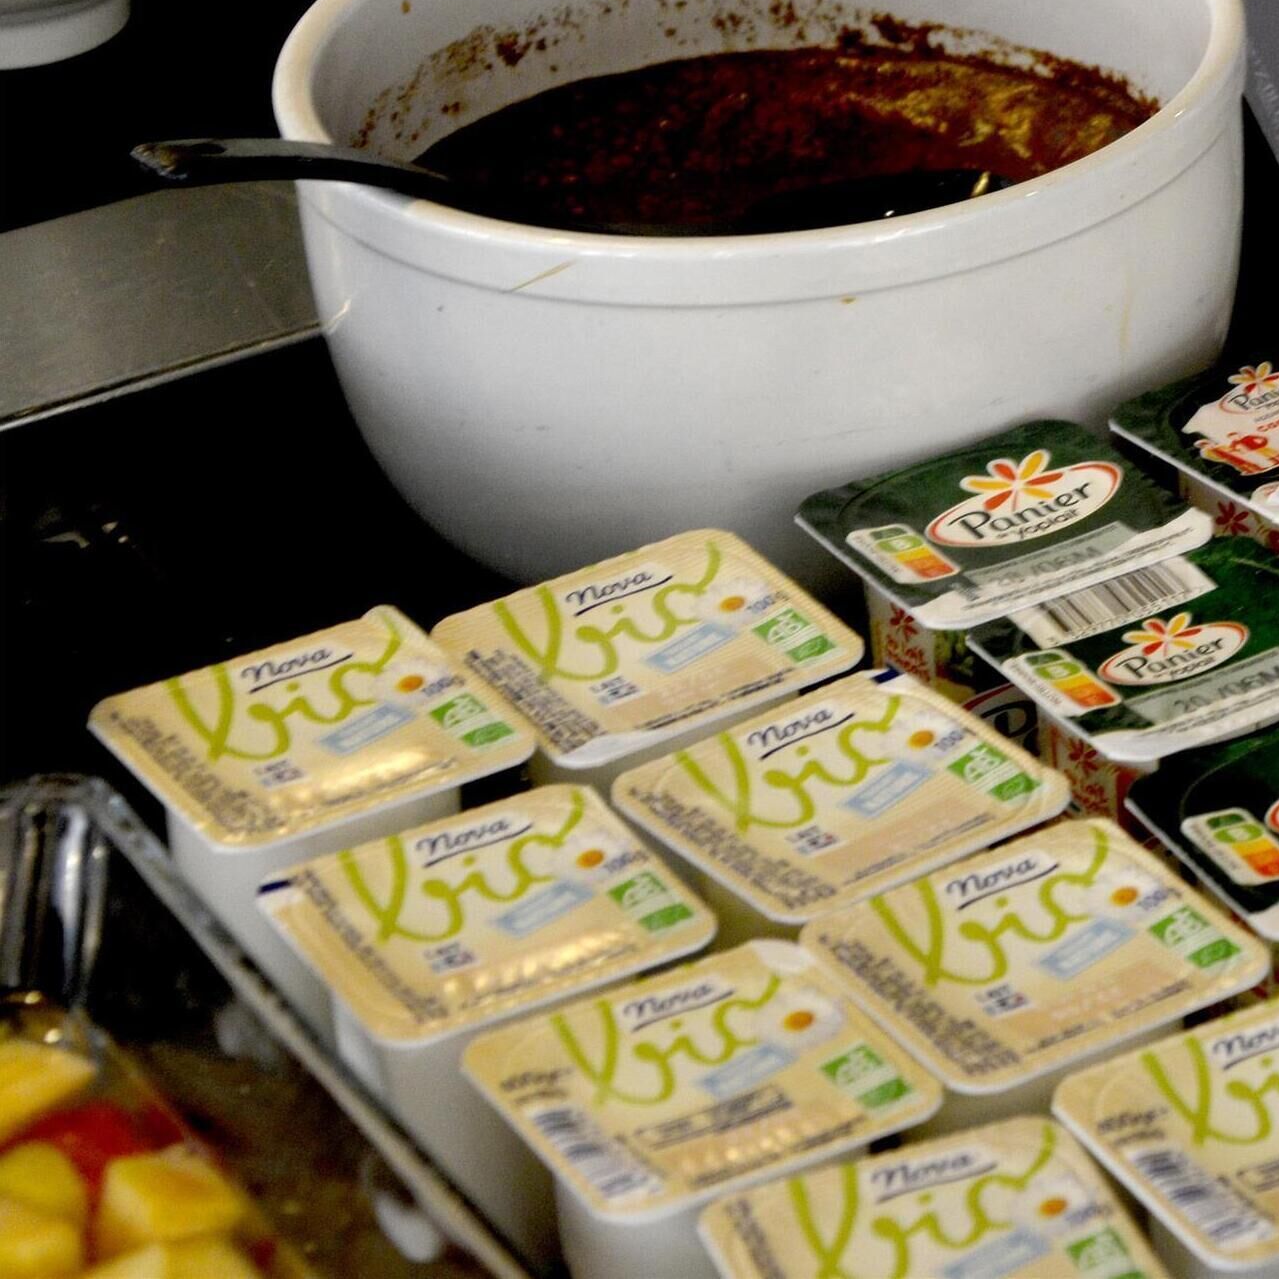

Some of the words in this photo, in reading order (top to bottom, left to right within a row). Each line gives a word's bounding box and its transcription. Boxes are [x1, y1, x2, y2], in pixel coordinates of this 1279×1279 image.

[948, 479, 1092, 540] Panier
[565, 570, 653, 607] Nova
[240, 648, 332, 683] Nova
[1112, 634, 1226, 680] Panier
[746, 706, 835, 749] Nova
[415, 818, 512, 856] Nova
[946, 857, 1037, 898] Nova
